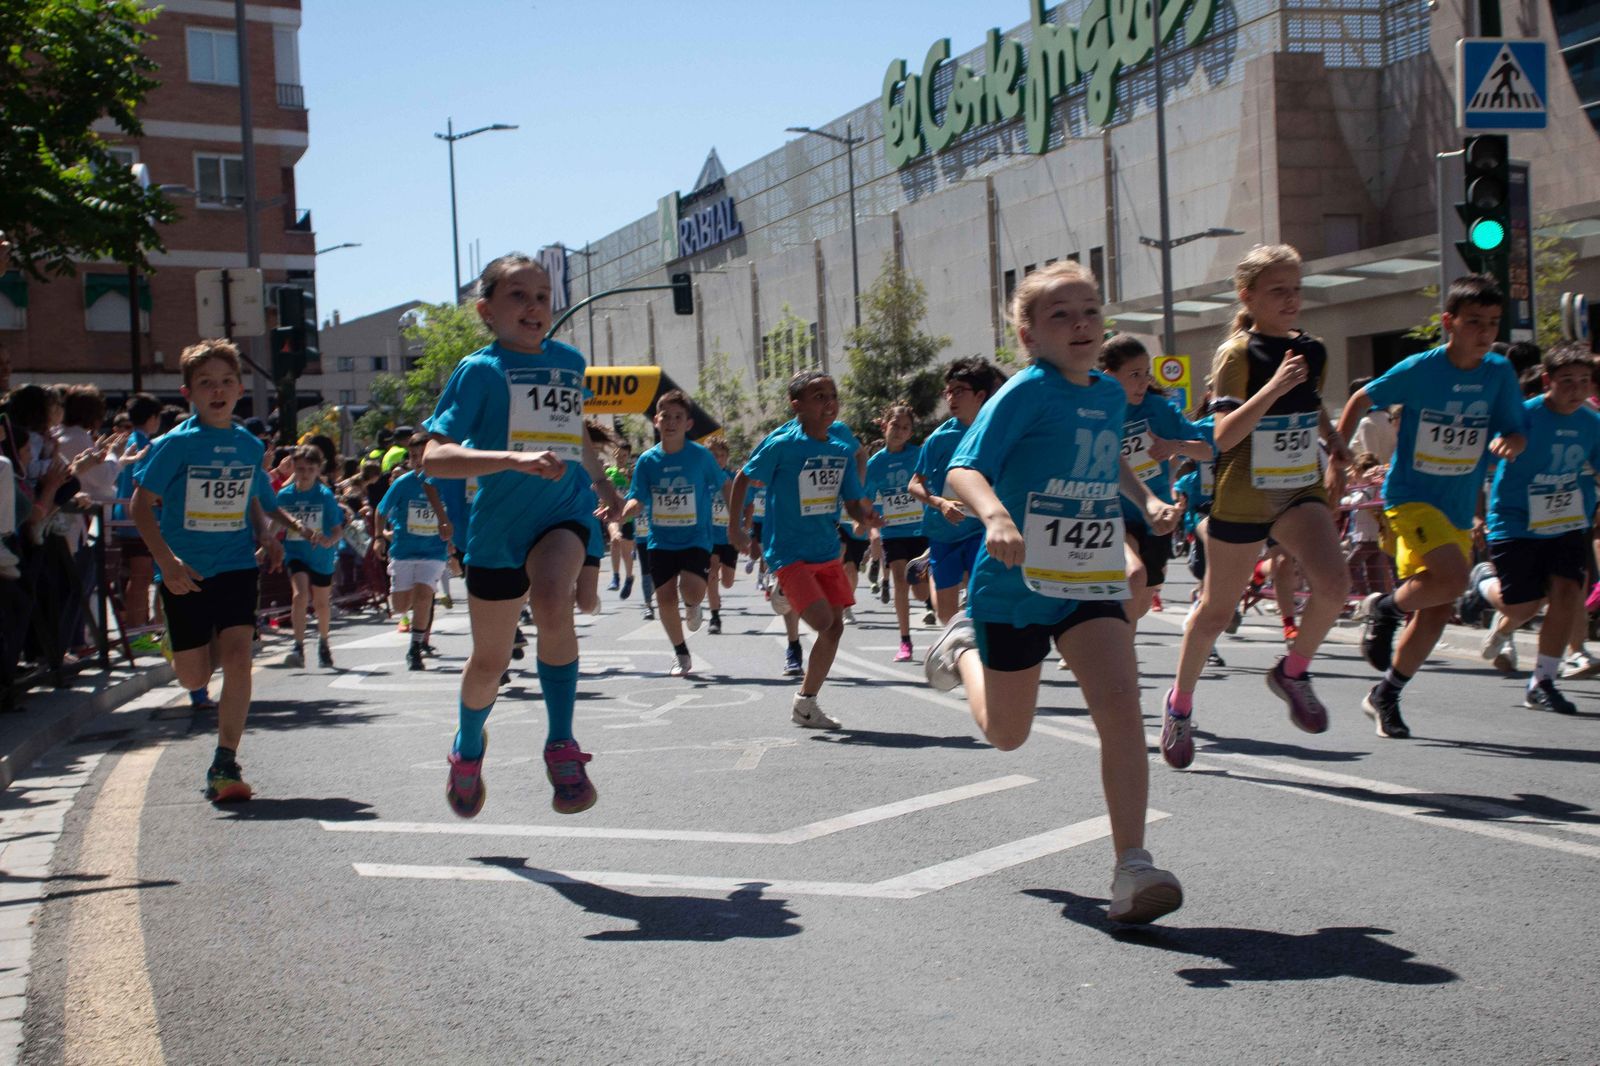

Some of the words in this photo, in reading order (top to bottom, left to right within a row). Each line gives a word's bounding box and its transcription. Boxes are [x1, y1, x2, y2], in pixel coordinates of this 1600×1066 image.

[882, 58, 922, 170] El
[920, 38, 1028, 151] Corte
[1165, 365, 1180, 375] 30
[1274, 430, 1311, 452] 550
[1431, 426, 1479, 446] 1918
[200, 480, 246, 499] 1854
[658, 495, 688, 506] 1541
[887, 496, 916, 507] 1434
[1544, 493, 1574, 510] 752
[415, 509, 438, 520] 187
[1045, 519, 1114, 549] 1422
